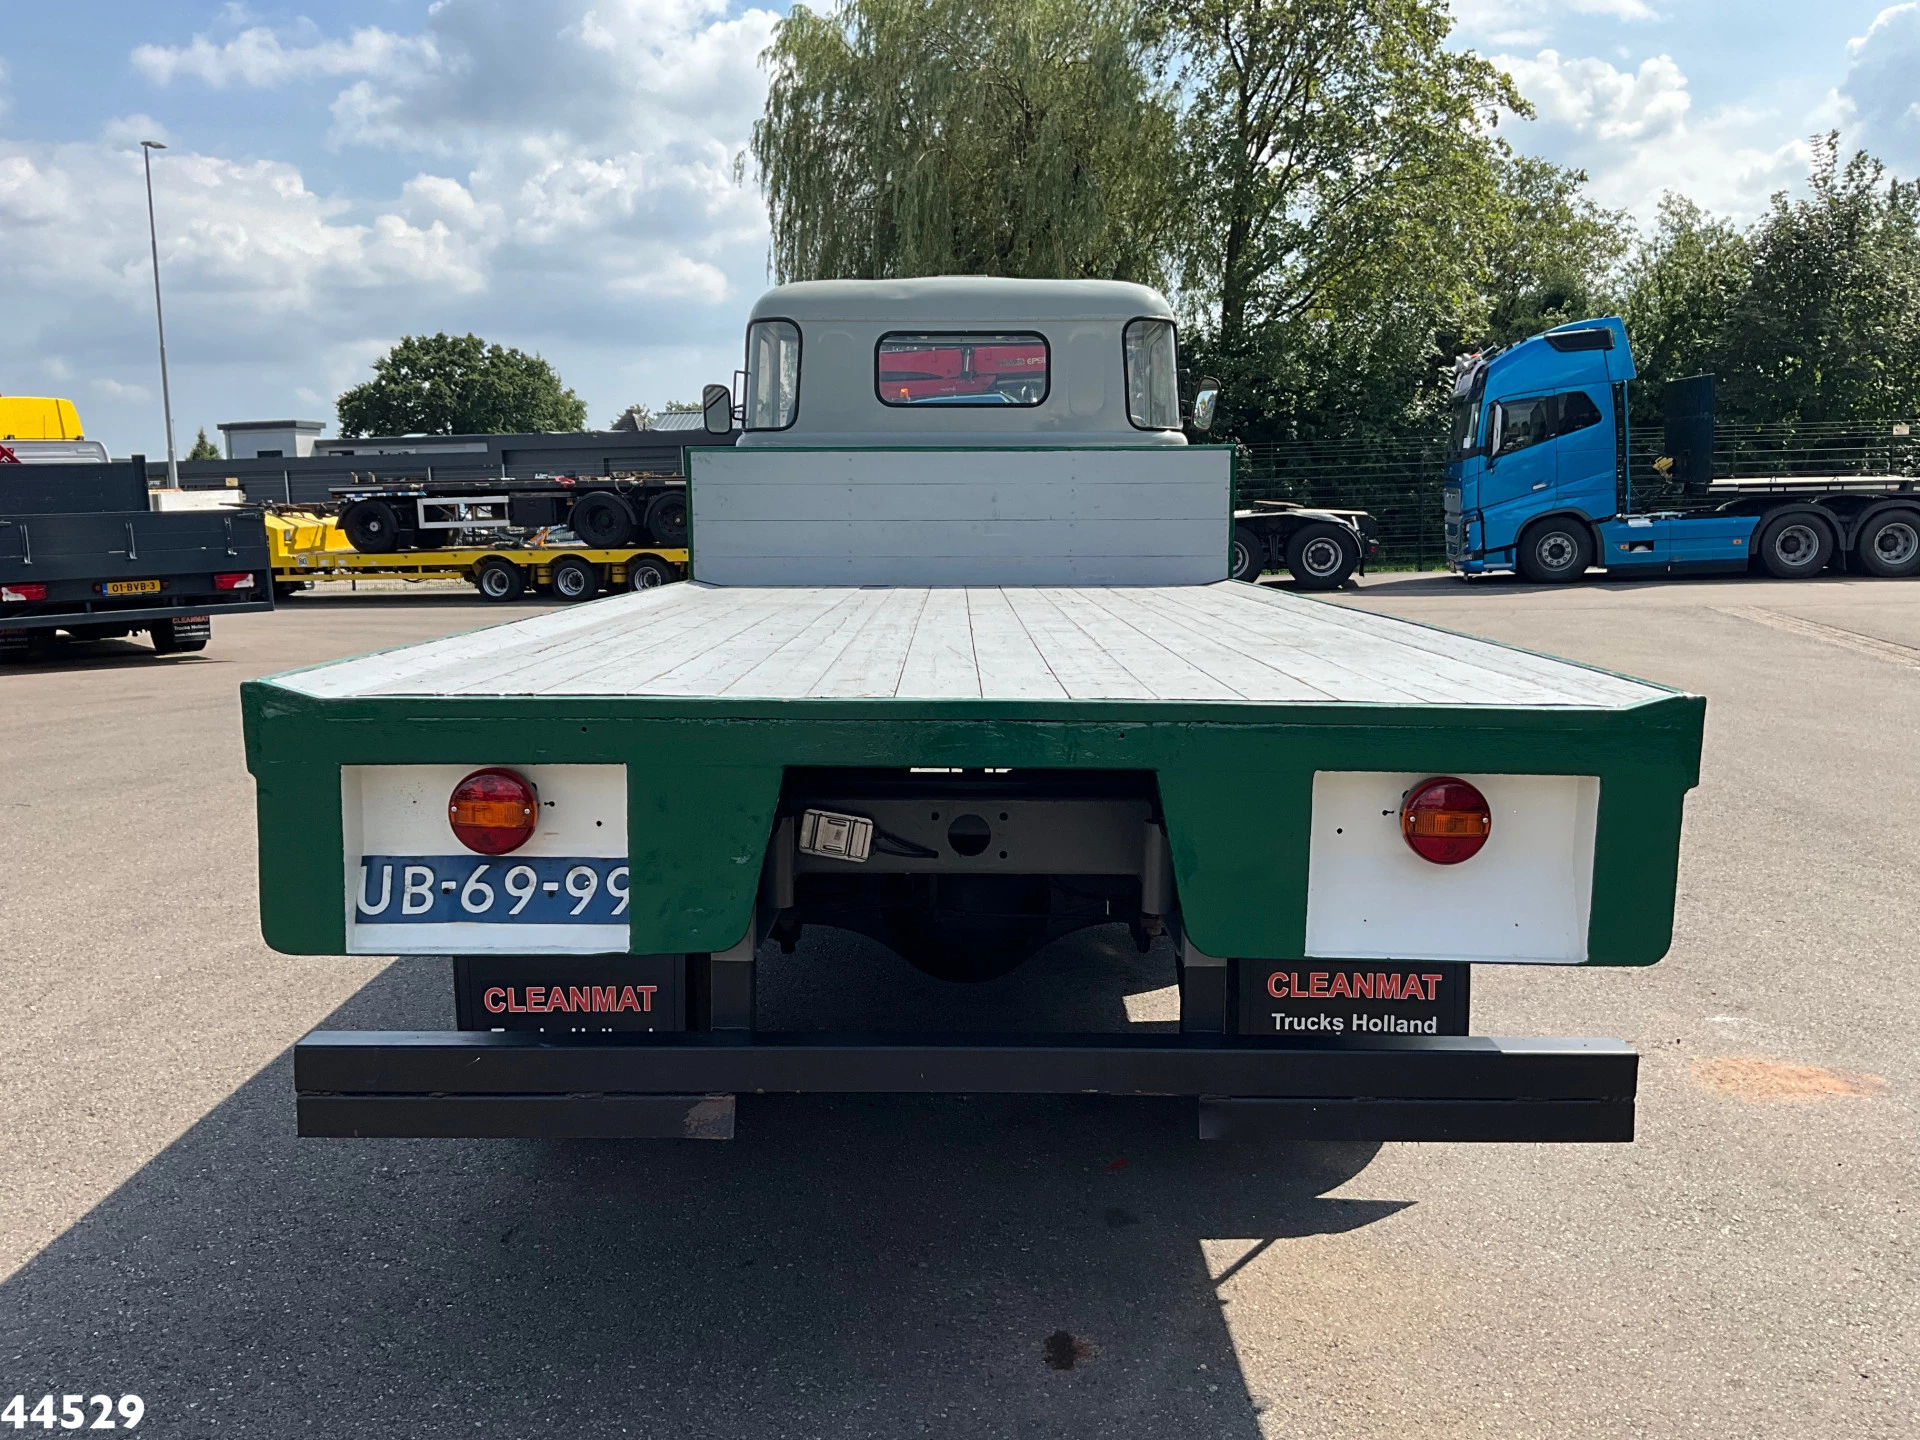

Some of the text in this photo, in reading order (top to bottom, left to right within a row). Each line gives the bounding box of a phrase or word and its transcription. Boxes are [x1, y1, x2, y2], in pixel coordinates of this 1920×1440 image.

[112, 581, 156, 593] 01-BVB-3
[356, 864, 630, 916] UB-69-99
[483, 985, 658, 1014] CLEANMAT
[1267, 971, 1443, 1001] CLEANMAT
[1271, 1012, 1438, 1034] Trucks Holland
